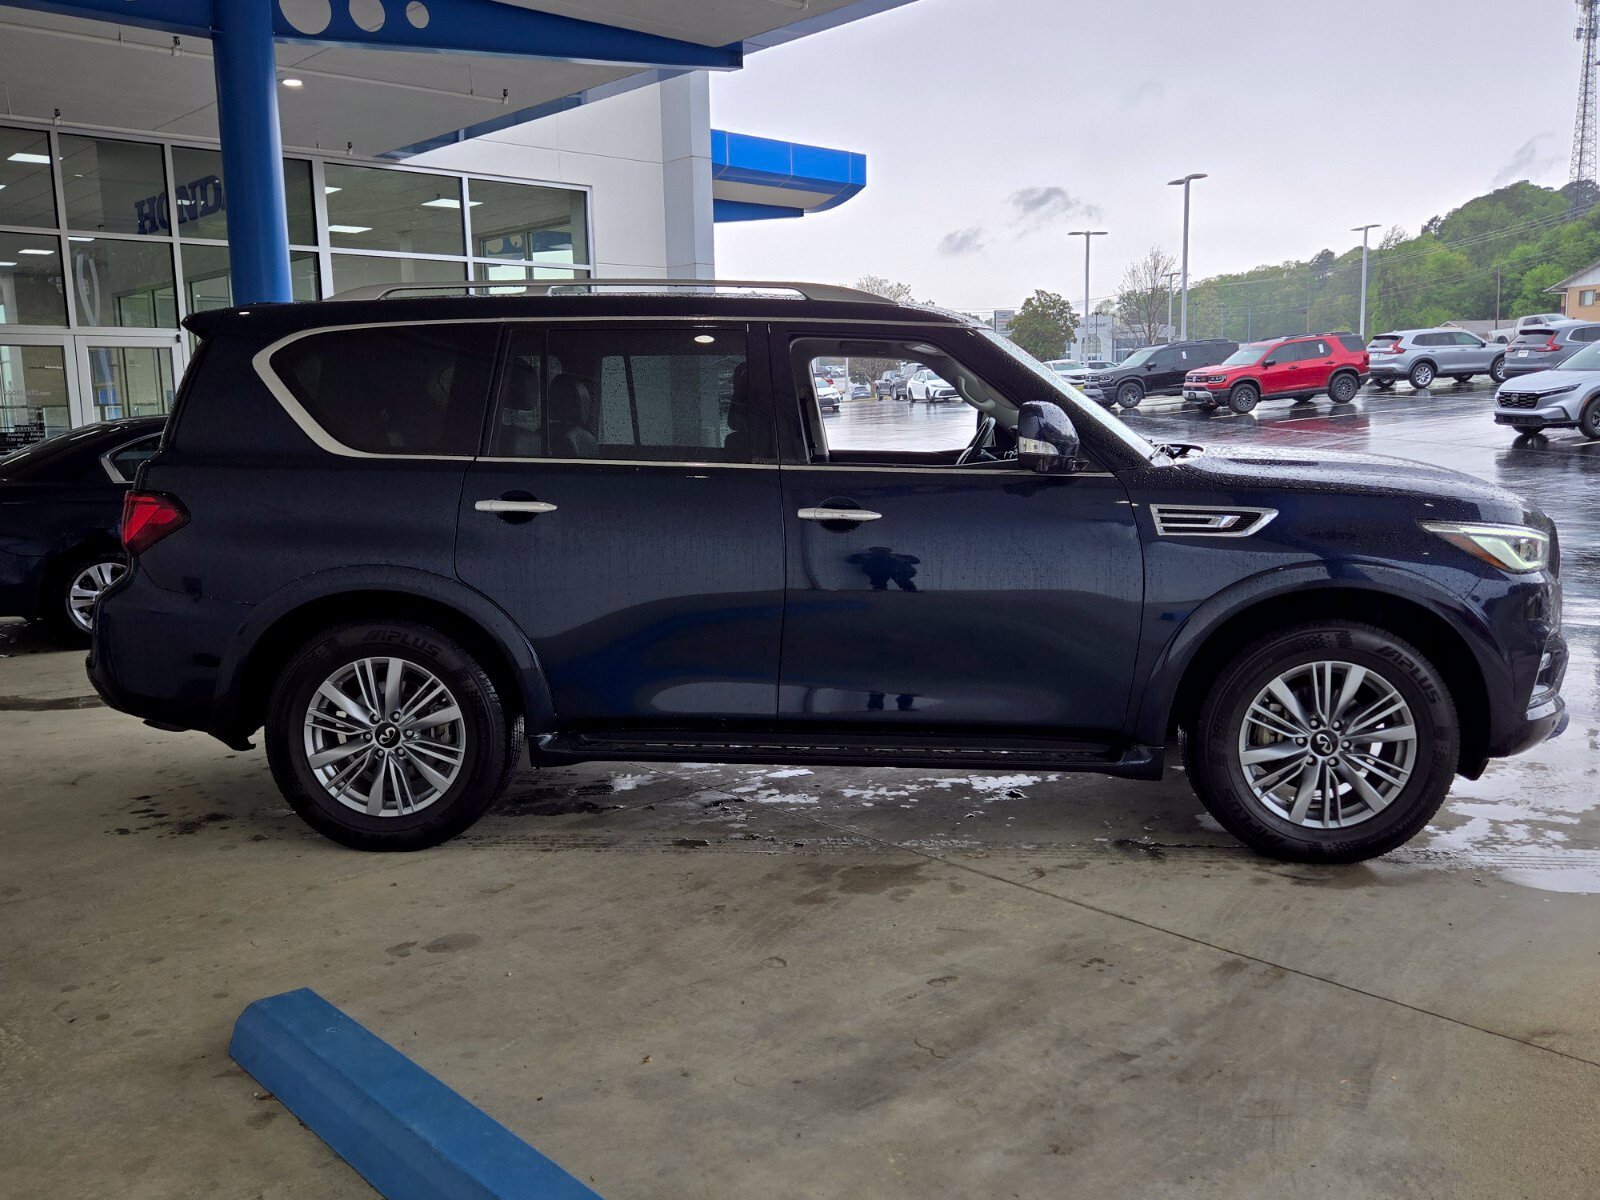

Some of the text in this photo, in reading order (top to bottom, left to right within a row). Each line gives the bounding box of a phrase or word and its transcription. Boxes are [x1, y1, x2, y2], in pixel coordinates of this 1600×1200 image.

[134, 174, 226, 235] HOND
[363, 629, 442, 657] APLUS
[1375, 645, 1442, 704] APLUS
